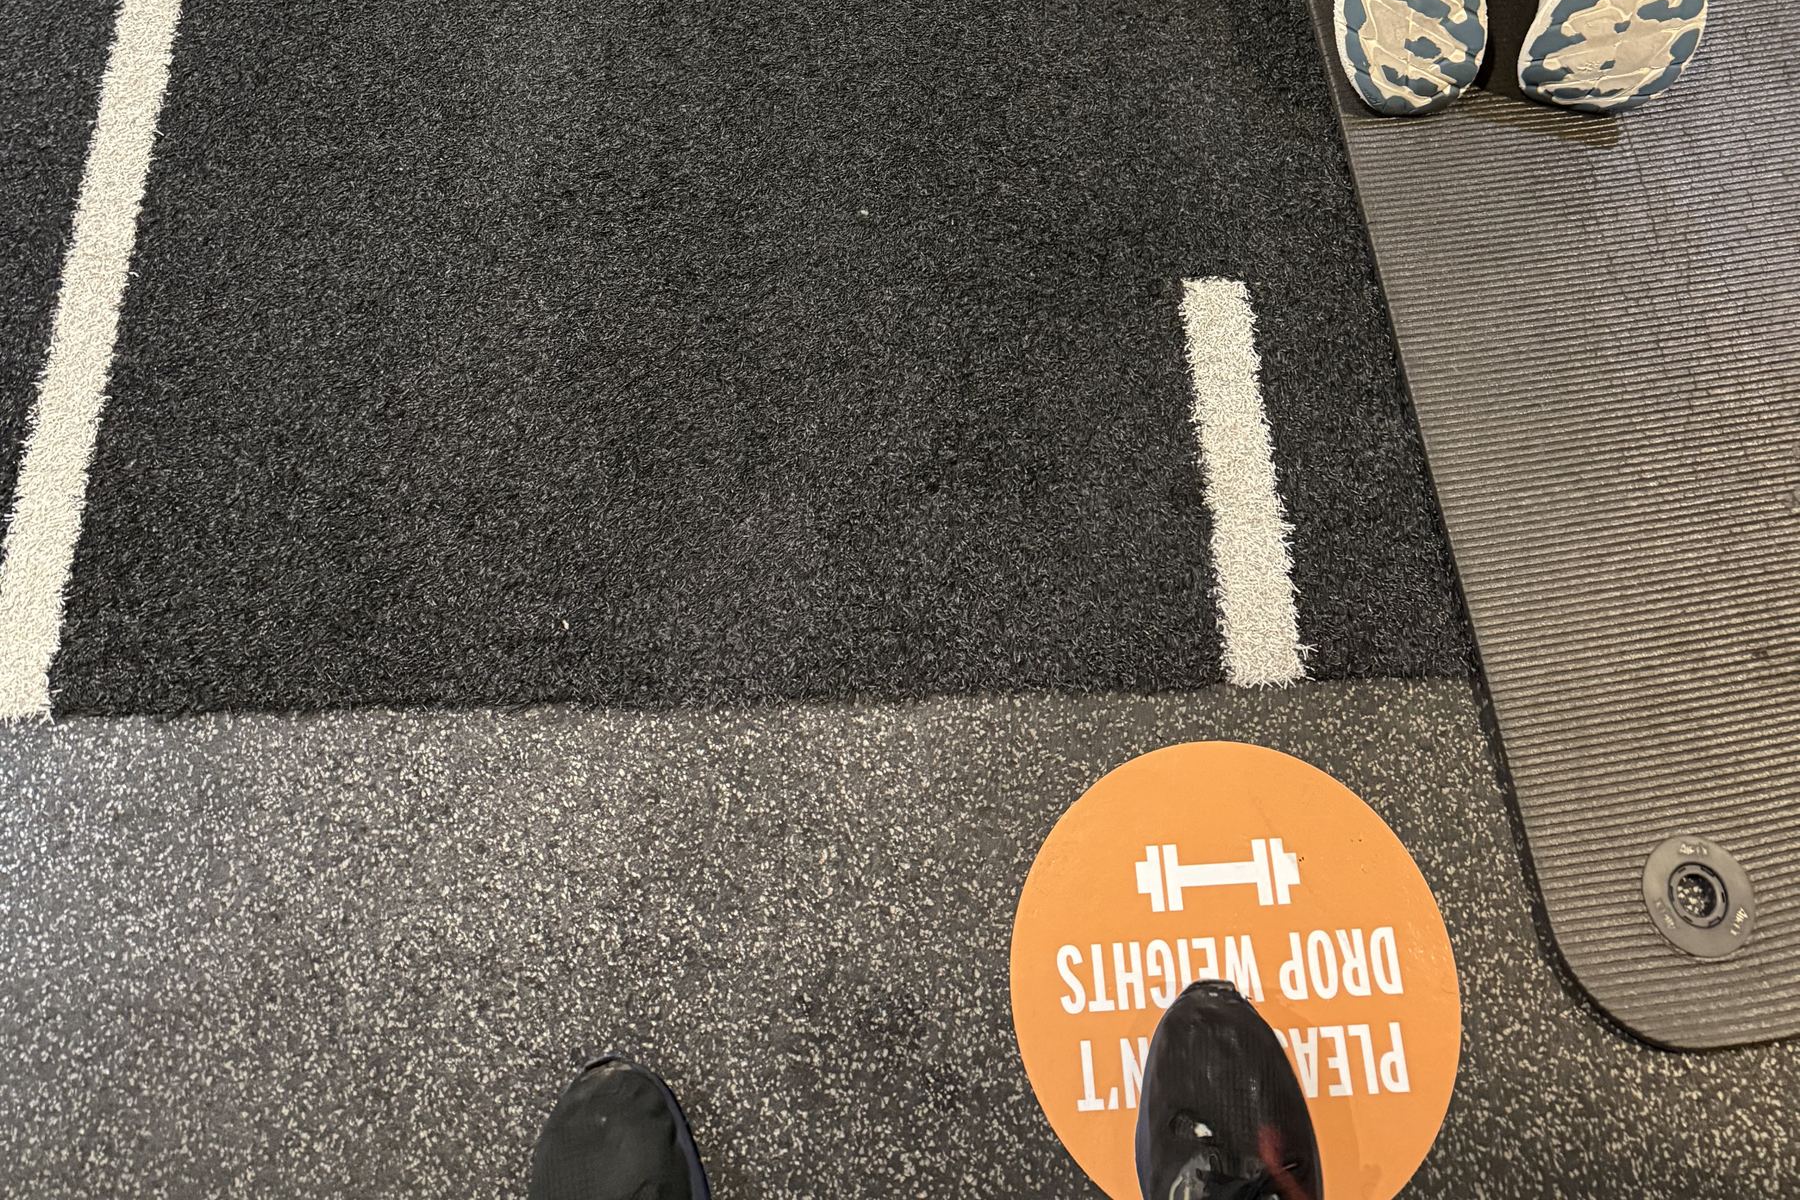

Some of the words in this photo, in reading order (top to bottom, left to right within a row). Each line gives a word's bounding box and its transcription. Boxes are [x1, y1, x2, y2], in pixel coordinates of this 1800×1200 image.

[1056, 935, 1265, 1015] WEIGHTS
[1279, 926, 1404, 1001] DROP
[1076, 1036, 1149, 1112] N'T
[1273, 1021, 1411, 1099] PLEA
